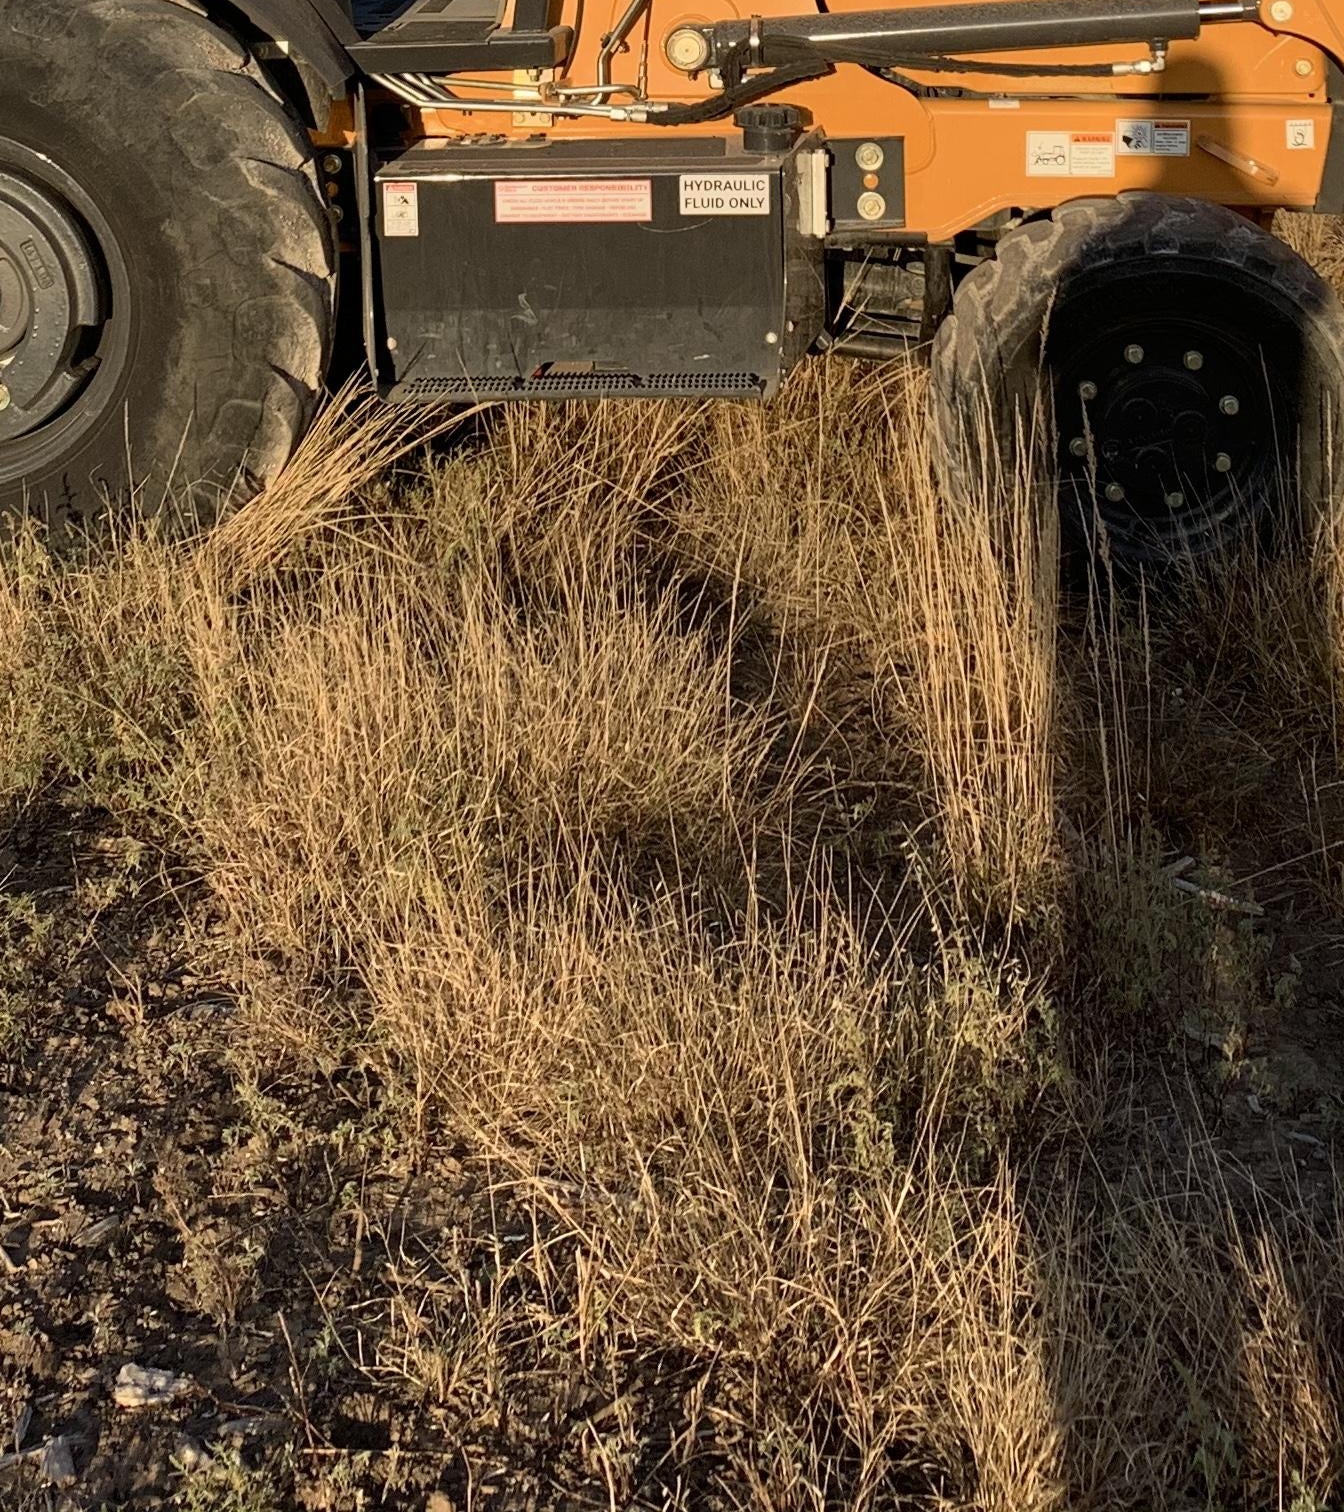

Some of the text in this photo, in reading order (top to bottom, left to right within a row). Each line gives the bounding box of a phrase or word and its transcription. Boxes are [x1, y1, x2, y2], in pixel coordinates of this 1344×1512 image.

[684, 180, 766, 191] HYDRAULIC
[685, 197, 765, 209] FLUID ONLY
